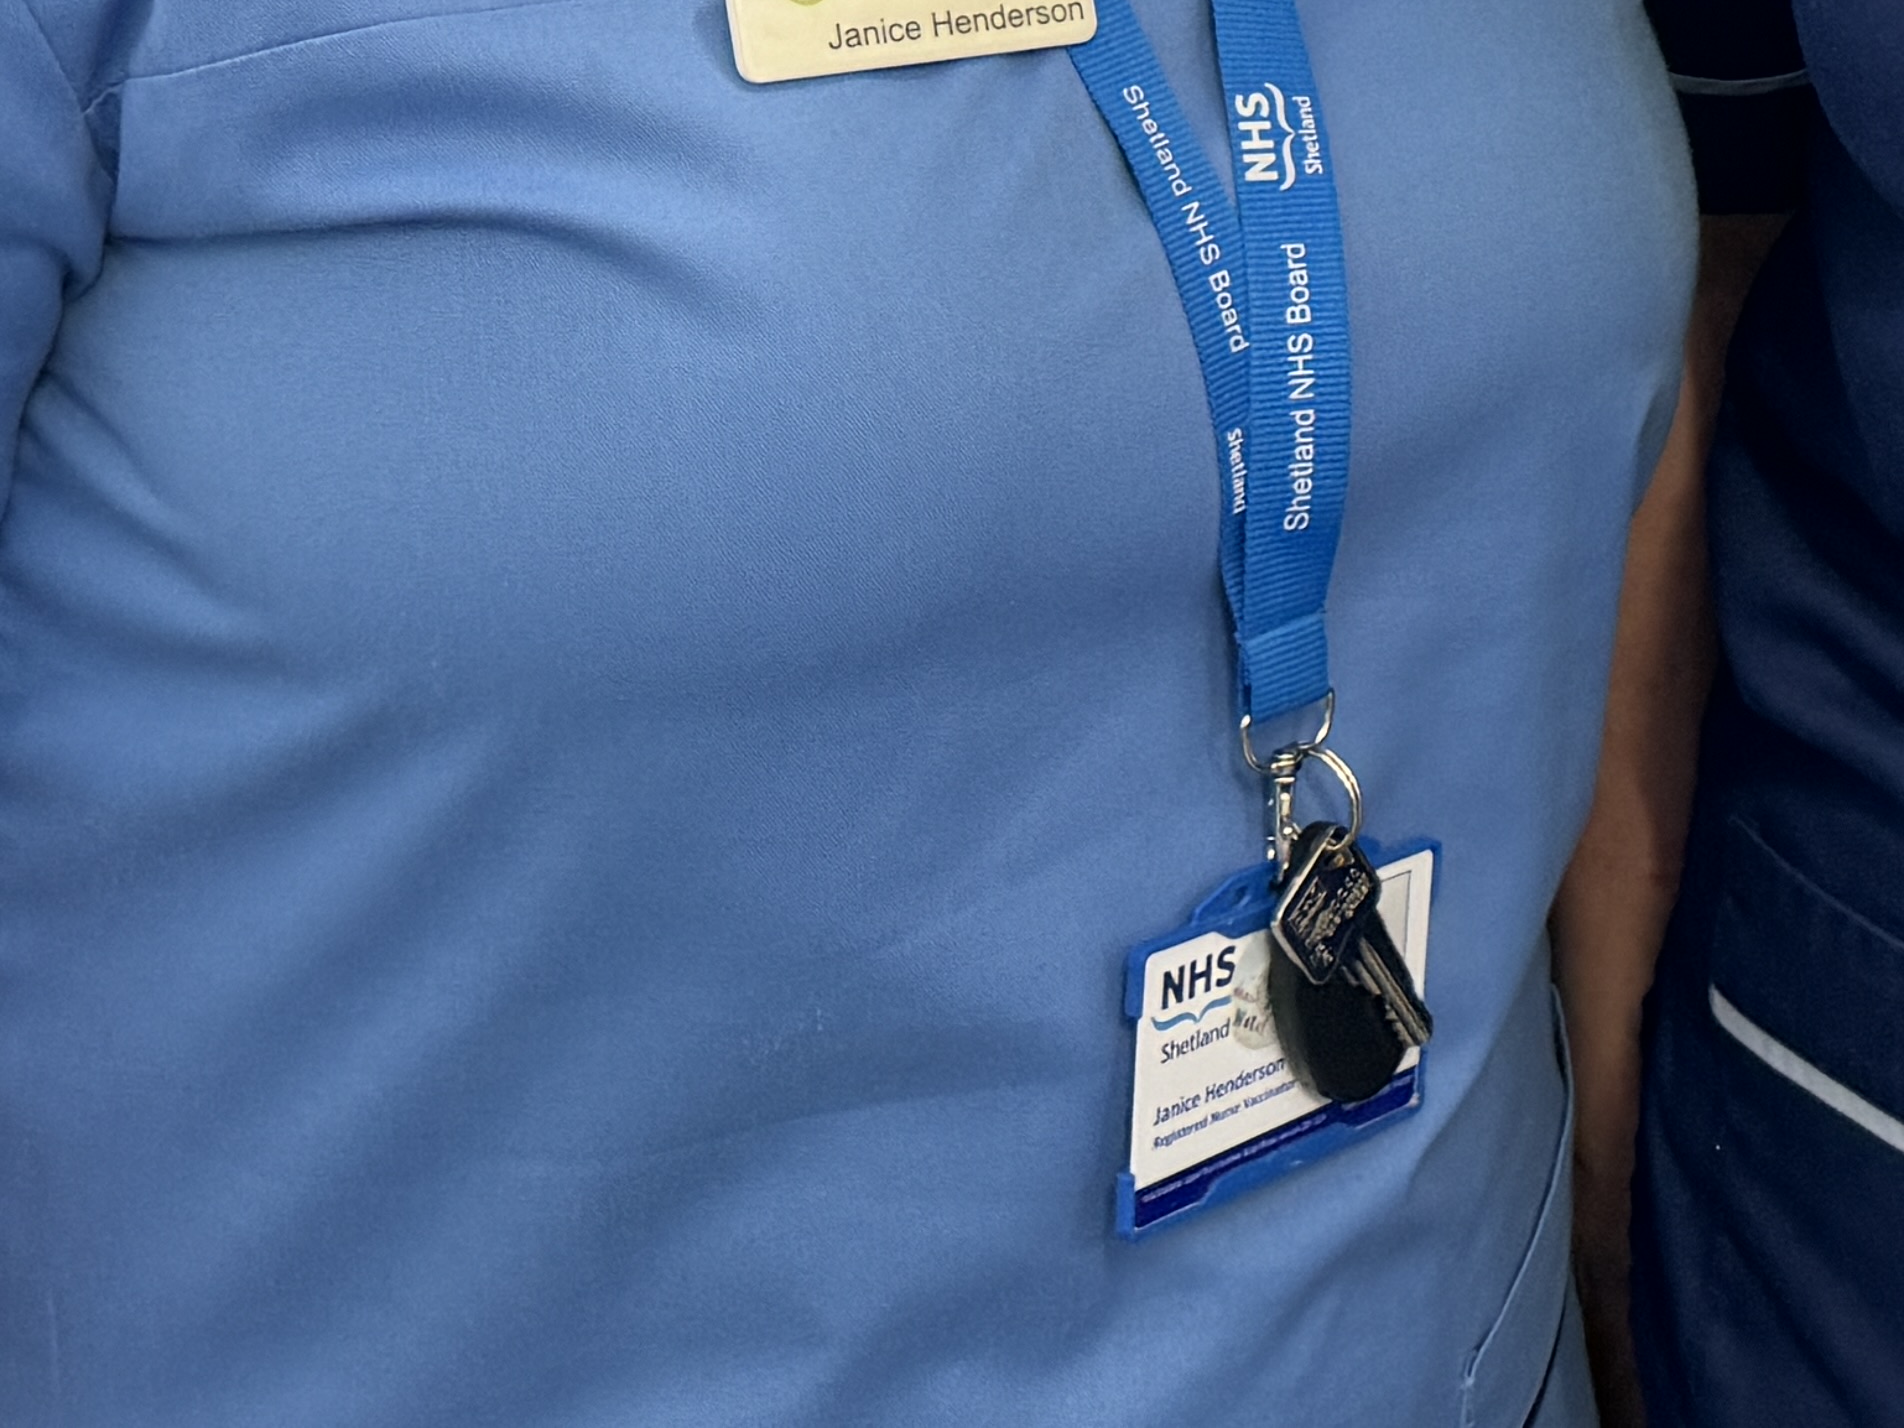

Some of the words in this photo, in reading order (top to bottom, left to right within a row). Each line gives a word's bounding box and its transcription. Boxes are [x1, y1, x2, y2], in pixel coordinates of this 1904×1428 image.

[828, 17, 923, 51] Janice
[930, 0, 1086, 38] Henderson
[1234, 91, 1280, 182] NHS
[1292, 95, 1323, 175] Shetland
[1123, 84, 1192, 196] Shetland
[1181, 201, 1221, 266] NHS
[1208, 270, 1250, 354] Board
[1281, 242, 1311, 325] Board
[1286, 332, 1315, 401] NHS
[1284, 409, 1315, 531] Shetland
[1161, 945, 1236, 1011] NHS
[1160, 1017, 1231, 1064] Shetland
[1153, 1094, 1202, 1127] Janice
[1204, 1056, 1287, 1104] Henderson
